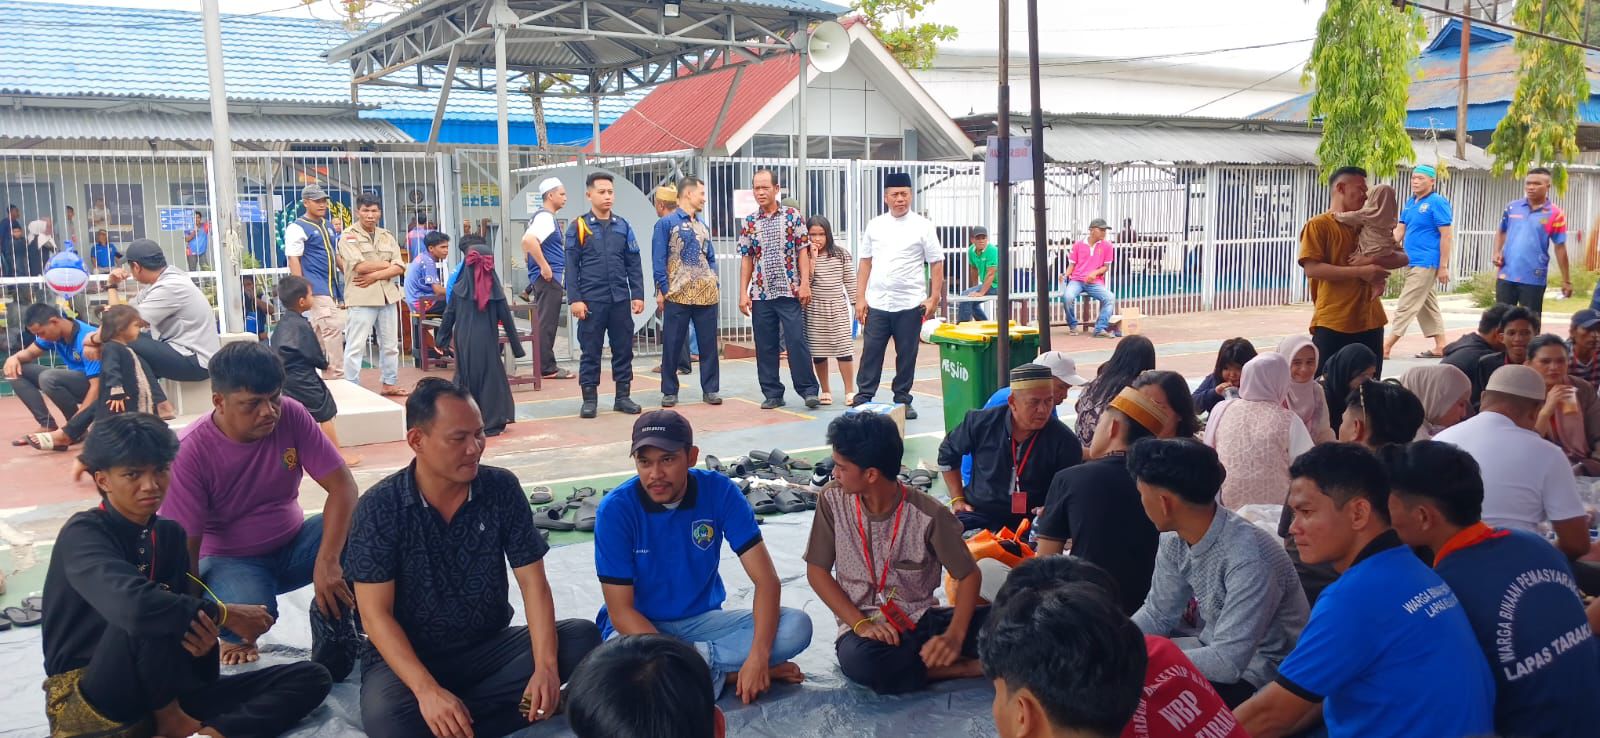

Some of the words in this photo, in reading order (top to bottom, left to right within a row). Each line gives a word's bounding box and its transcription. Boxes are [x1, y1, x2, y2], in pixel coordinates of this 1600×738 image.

[1499, 582, 1523, 621] BINAAN
[1515, 568, 1581, 598] PEMASYARAK
[1402, 590, 1432, 614] WARGA
[1496, 622, 1516, 663] WARGA
[1503, 646, 1553, 681] LAPAS
[1158, 689, 1203, 731] WBP
